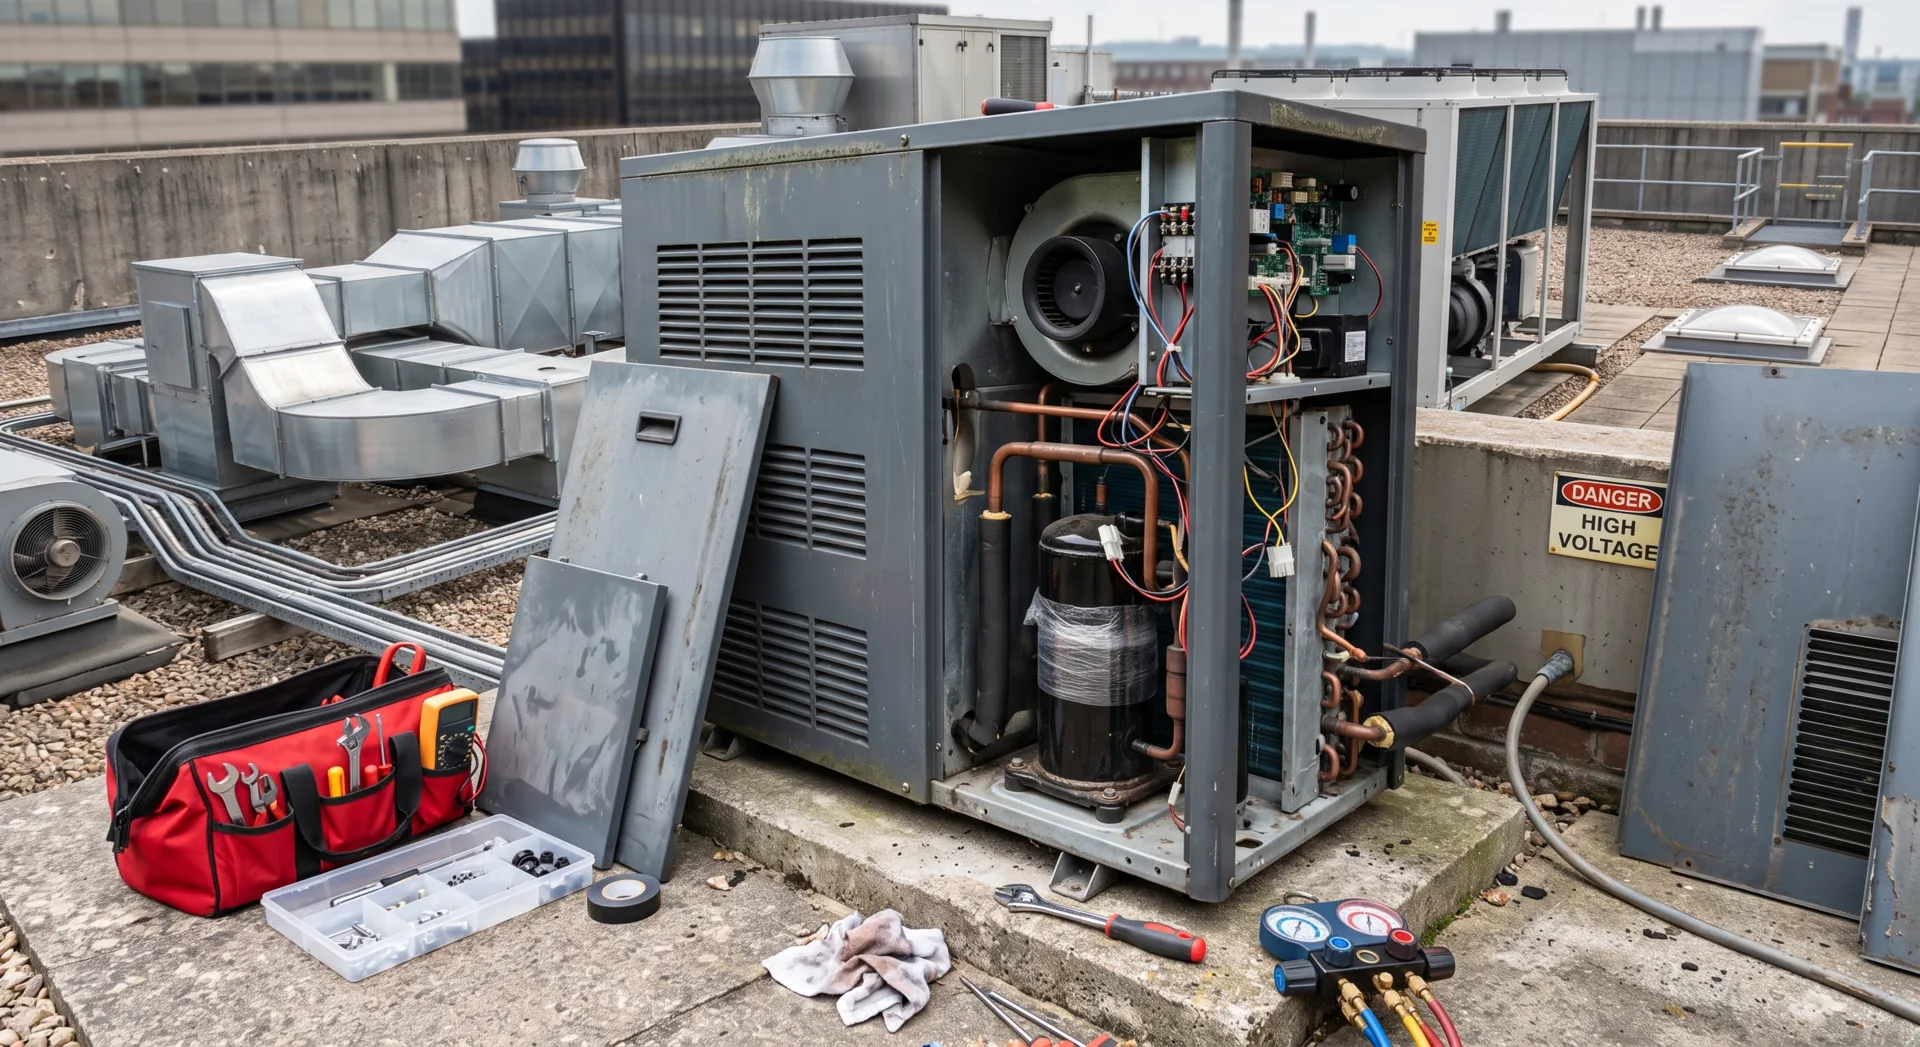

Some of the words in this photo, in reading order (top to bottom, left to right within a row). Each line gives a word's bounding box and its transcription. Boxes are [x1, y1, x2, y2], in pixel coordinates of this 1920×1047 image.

[1572, 485, 1652, 509] DANGER
[1582, 514, 1636, 536] HIGH
[1558, 532, 1659, 562] VOLTAGE
